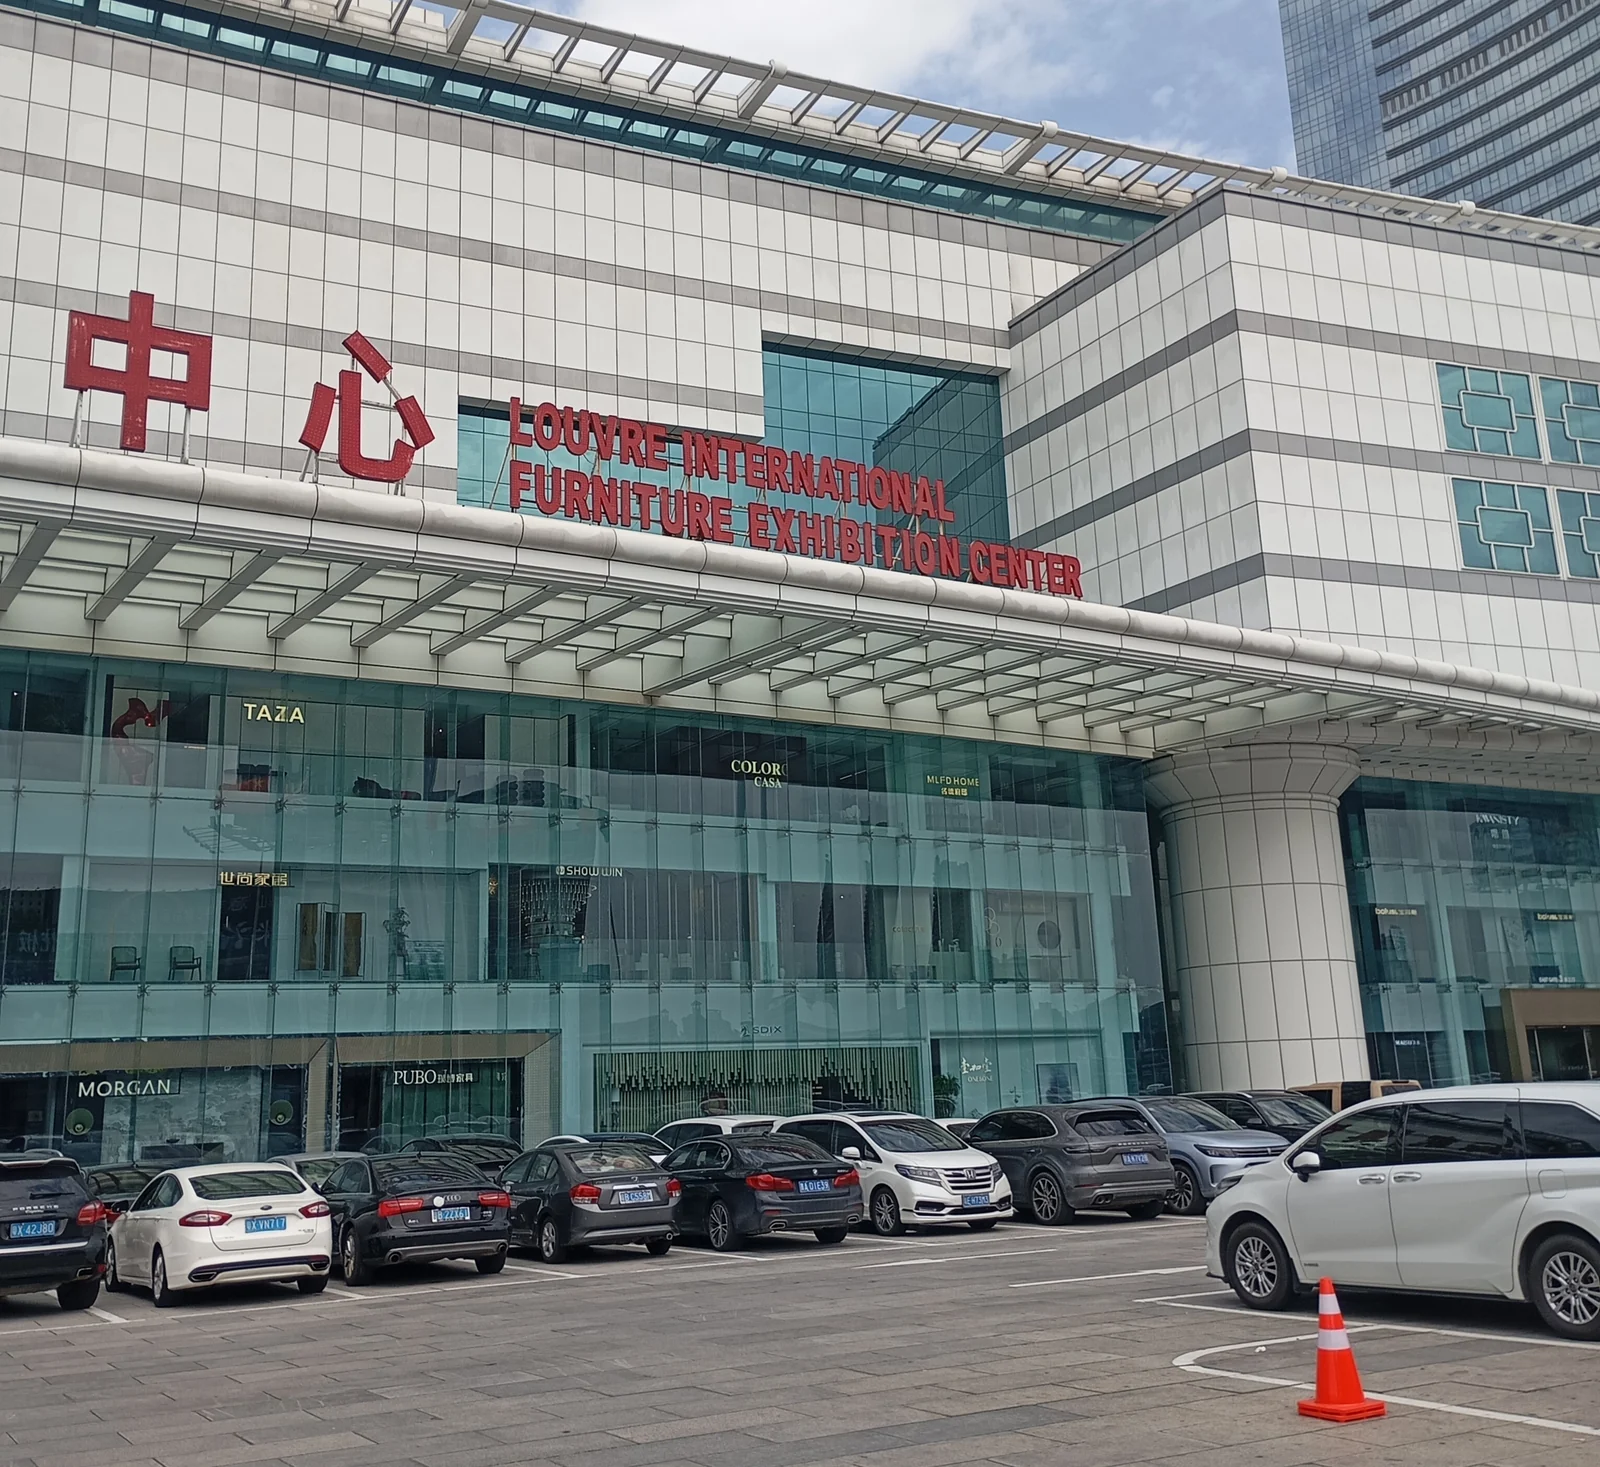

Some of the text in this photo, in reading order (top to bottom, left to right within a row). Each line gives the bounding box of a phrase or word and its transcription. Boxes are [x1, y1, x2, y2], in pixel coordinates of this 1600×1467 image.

[66, 291, 435, 481] 中心
[509, 397, 955, 522] LOUVRE INTERNATIONAL
[509, 460, 1083, 599] FURNITURE EXHIBITION CENTER
[243, 702, 306, 724] TAZA
[753, 776, 783, 789] CASA
[953, 776, 980, 787] HOME
[220, 871, 288, 887] 世尚家居
[752, 1026, 782, 1034] SDIX
[393, 1069, 437, 1085] PUBO
[78, 1079, 171, 1098] MORGAN
